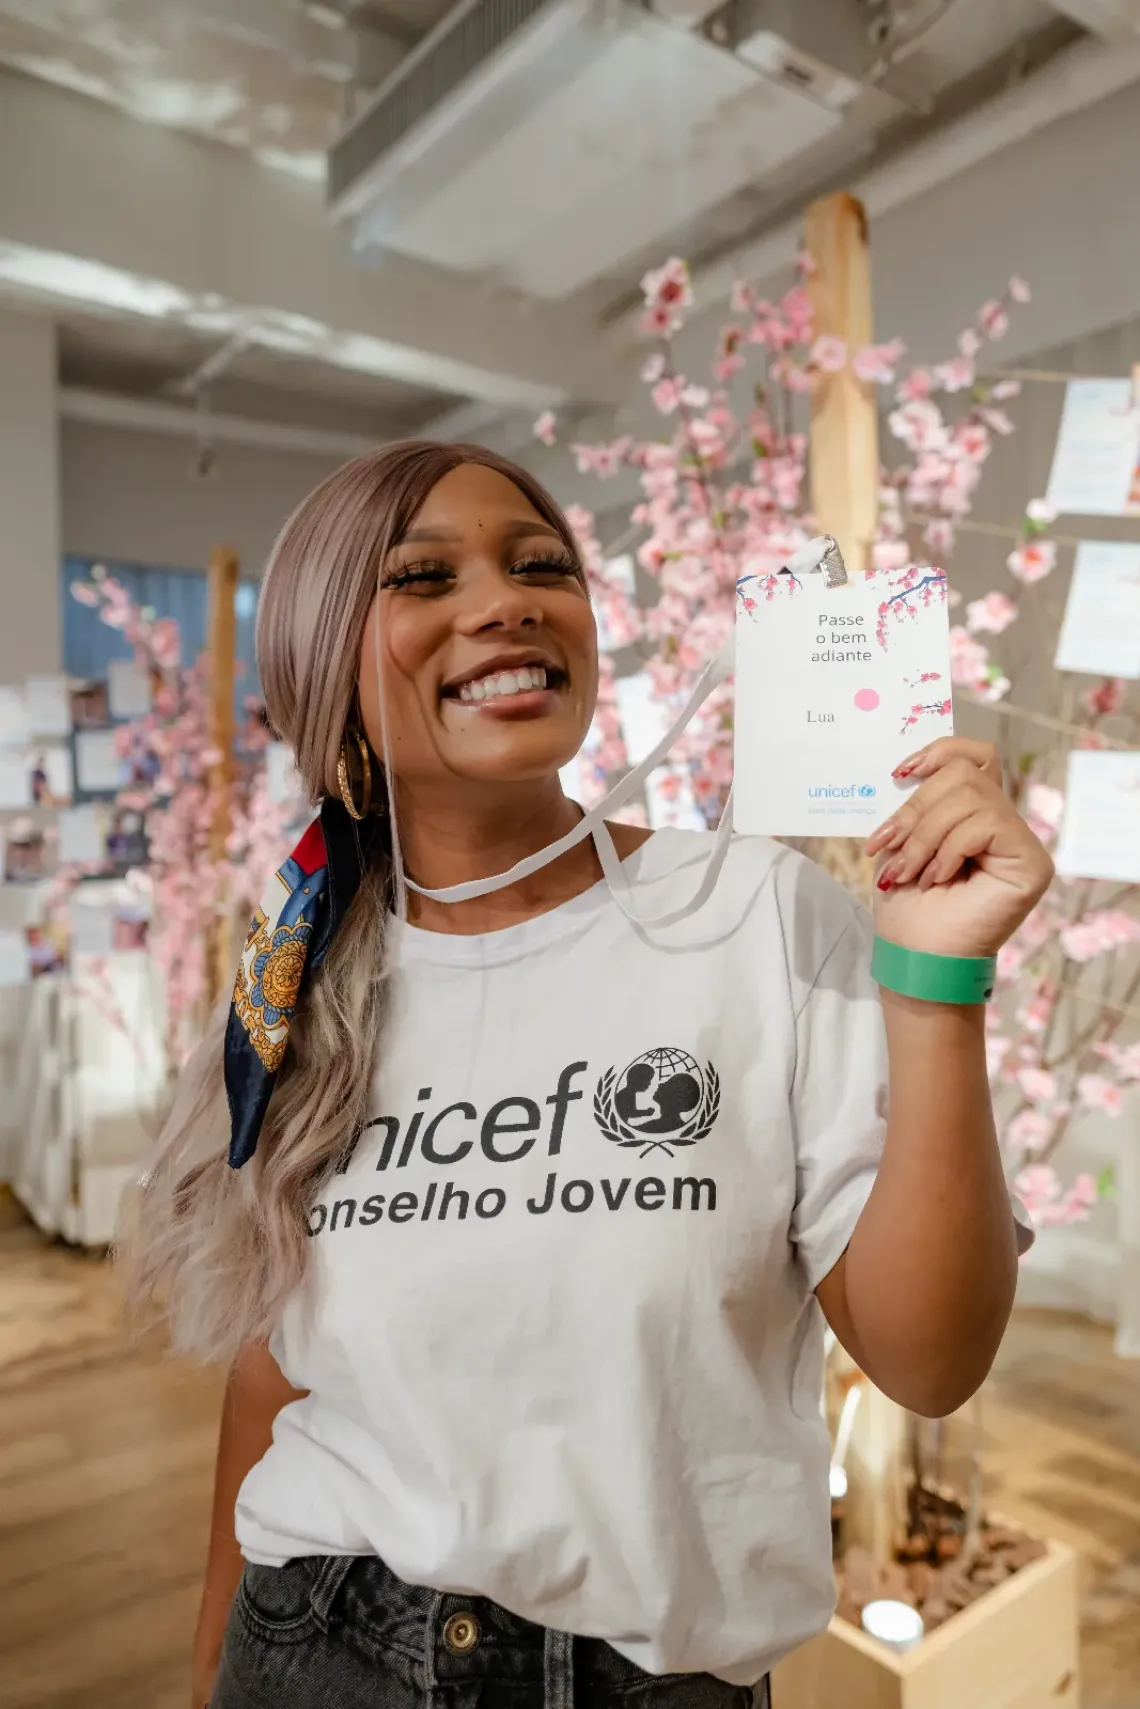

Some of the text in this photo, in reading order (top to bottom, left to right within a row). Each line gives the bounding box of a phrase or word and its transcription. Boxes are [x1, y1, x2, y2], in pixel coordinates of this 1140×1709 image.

[818, 614, 865, 627] Passe
[815, 631, 867, 644] o bem
[811, 649, 872, 663] adiante
[807, 711, 836, 723] Lua
[808, 784, 857, 798] unicef
[336, 1060, 588, 1175] nicef
[306, 1172, 717, 1237] onselho Jovem
